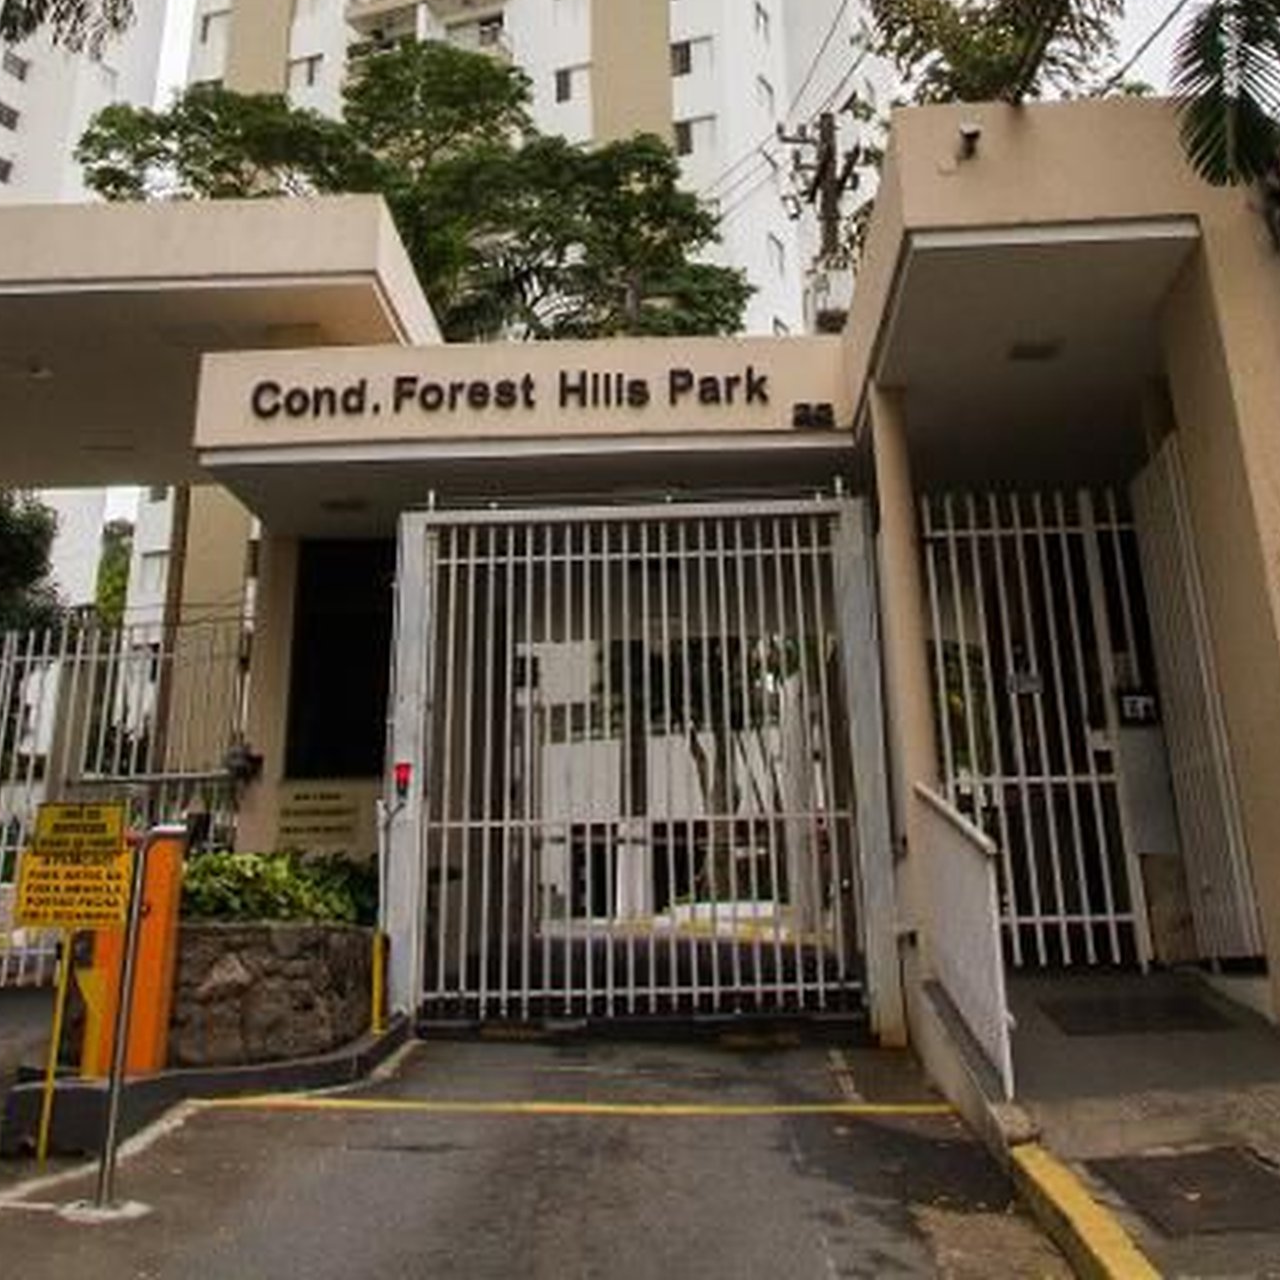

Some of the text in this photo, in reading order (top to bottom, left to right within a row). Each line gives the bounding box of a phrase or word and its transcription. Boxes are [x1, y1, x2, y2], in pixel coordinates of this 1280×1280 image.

[251, 366, 769, 421] Cond. Forest Hills Park
